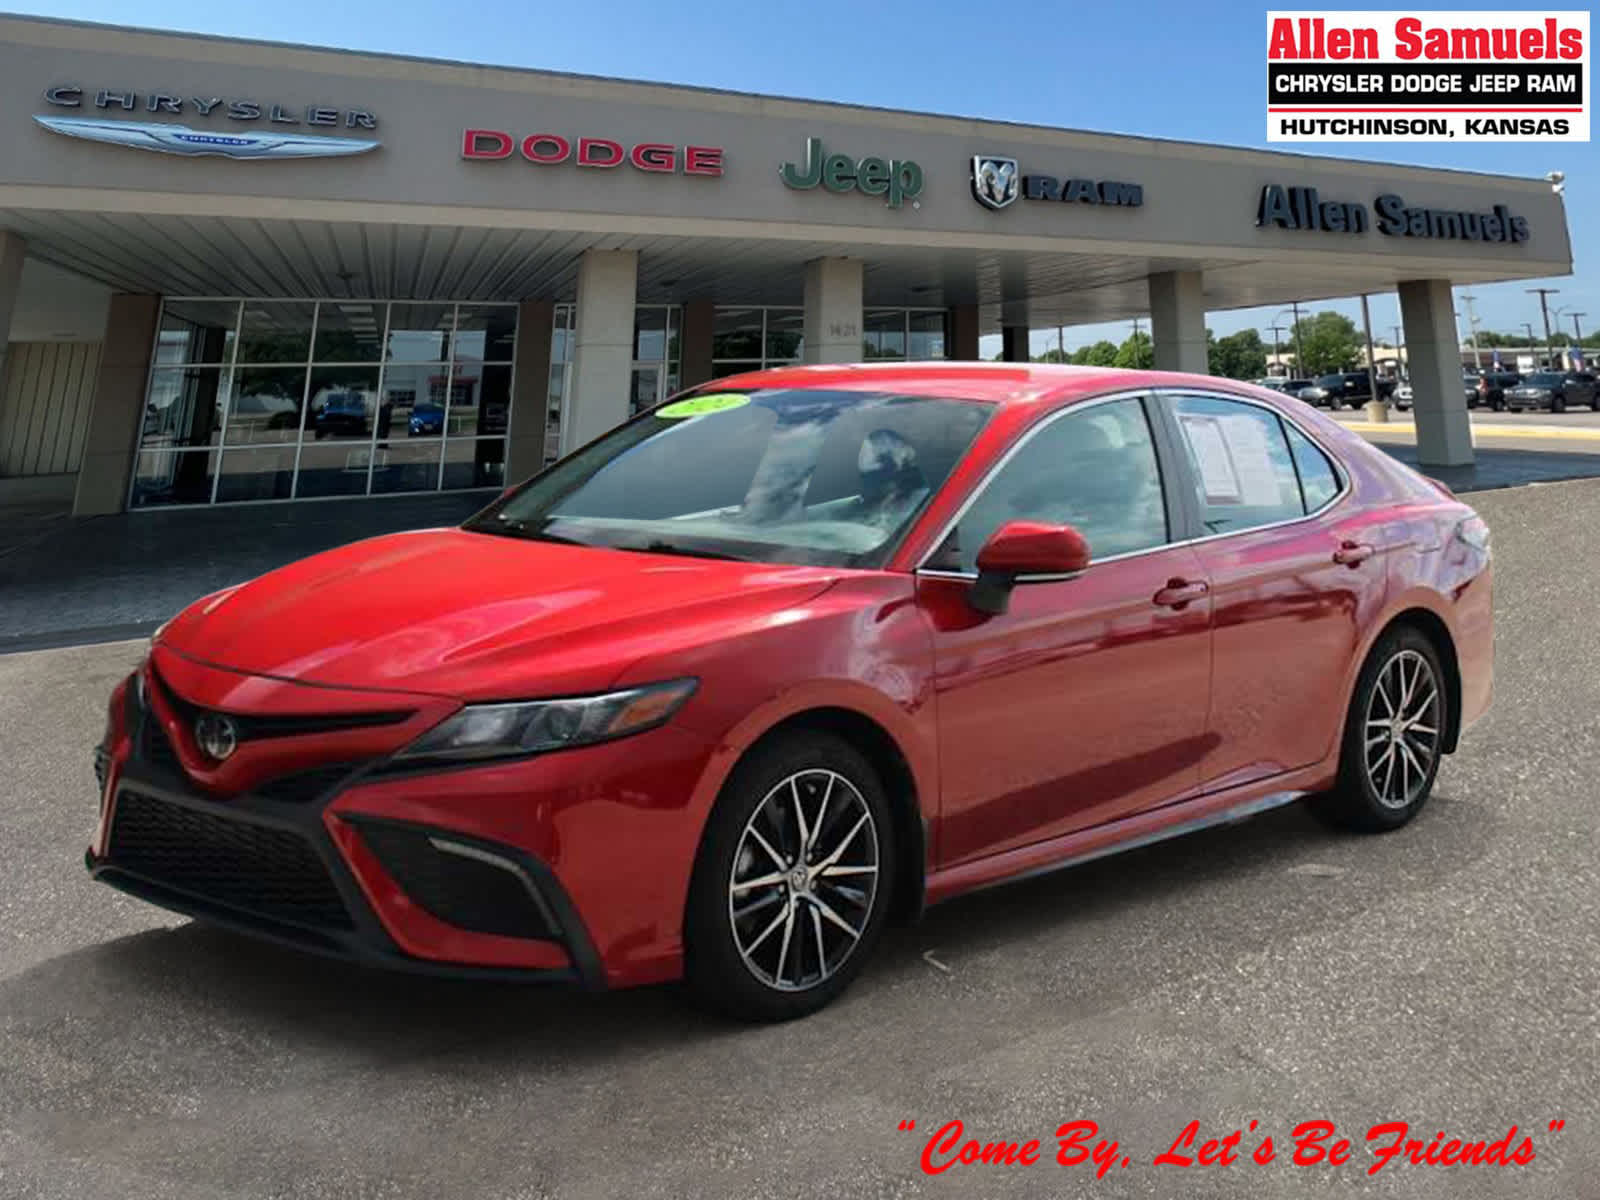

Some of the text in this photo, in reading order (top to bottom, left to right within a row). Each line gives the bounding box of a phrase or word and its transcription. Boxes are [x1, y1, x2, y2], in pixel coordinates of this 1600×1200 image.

[45, 87, 378, 129] CHRYSLER
[462, 128, 724, 176] DODGE
[779, 136, 924, 209] Jeep
[1022, 175, 1144, 207] RAM
[1256, 184, 1530, 243] Allen Samuels
